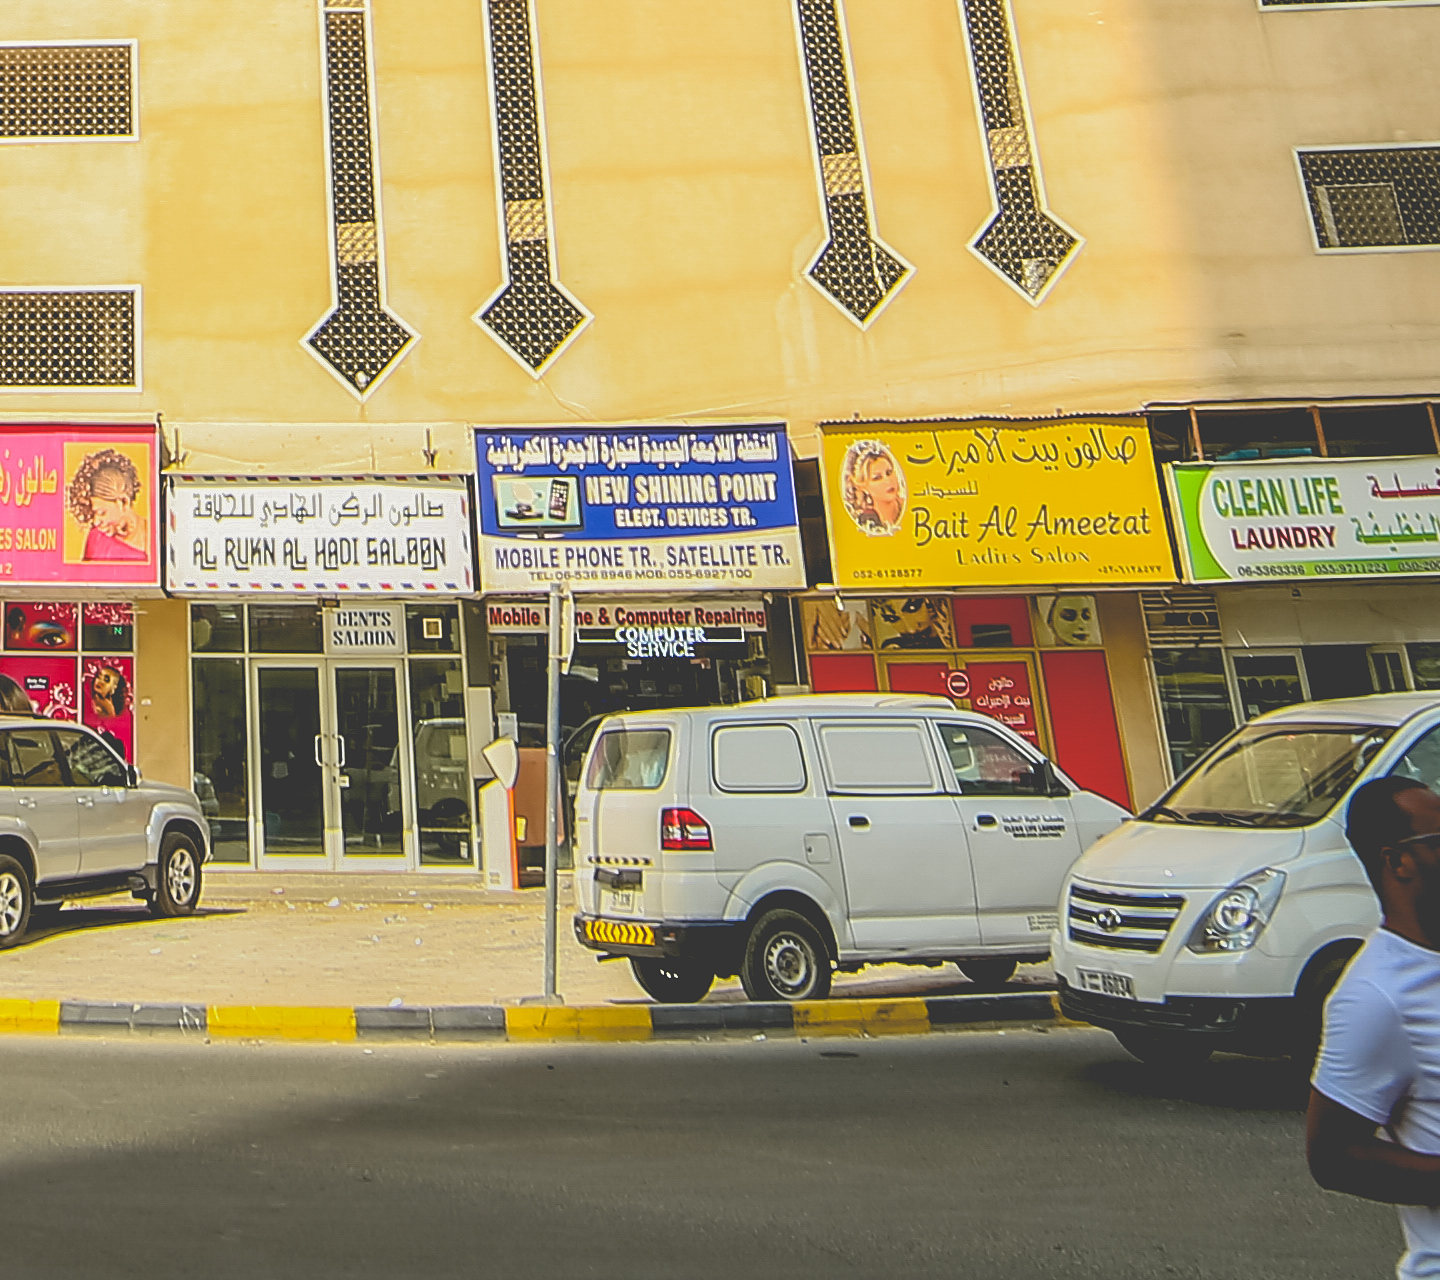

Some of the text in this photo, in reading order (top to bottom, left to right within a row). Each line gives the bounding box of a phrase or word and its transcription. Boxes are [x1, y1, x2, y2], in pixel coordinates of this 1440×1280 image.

[601, 434, 640, 470] لتجارة
[642, 434, 689, 470] الجديدة
[689, 434, 735, 463] اللامعة
[737, 433, 777, 462] النقطة
[1012, 437, 1059, 471] بيت
[1065, 428, 1137, 469] صالون
[15, 454, 58, 506] صالون
[586, 474, 777, 504] NEW SHINING POINT
[913, 480, 978, 500] للسيدات
[193, 492, 443, 528] صالون الركن الهادي للحلاقة
[1212, 476, 1344, 518] CLEAN LIFE
[615, 508, 756, 527] ELECT. DEVICES TR.
[912, 504, 1151, 546] Bait Al Ameerat
[15, 528, 56, 550] SALON
[1232, 525, 1335, 550] LAUNDRY
[193, 537, 446, 570] AL RUKN AL HADI SALOON
[496, 545, 790, 569] MOBILE PHONE SATELLITE TR.
[529, 572, 553, 580] TEL:
[854, 569, 922, 579] 052-6128577
[337, 611, 391, 627] GENTS
[490, 606, 541, 626] Mobile
[598, 607, 610, 624] &
[615, 607, 691, 627] Computer
[695, 607, 766, 628] Repairing
[333, 631, 396, 646] SALOON
[615, 627, 707, 643] COMPUTER
[627, 642, 695, 657] SERVICE
